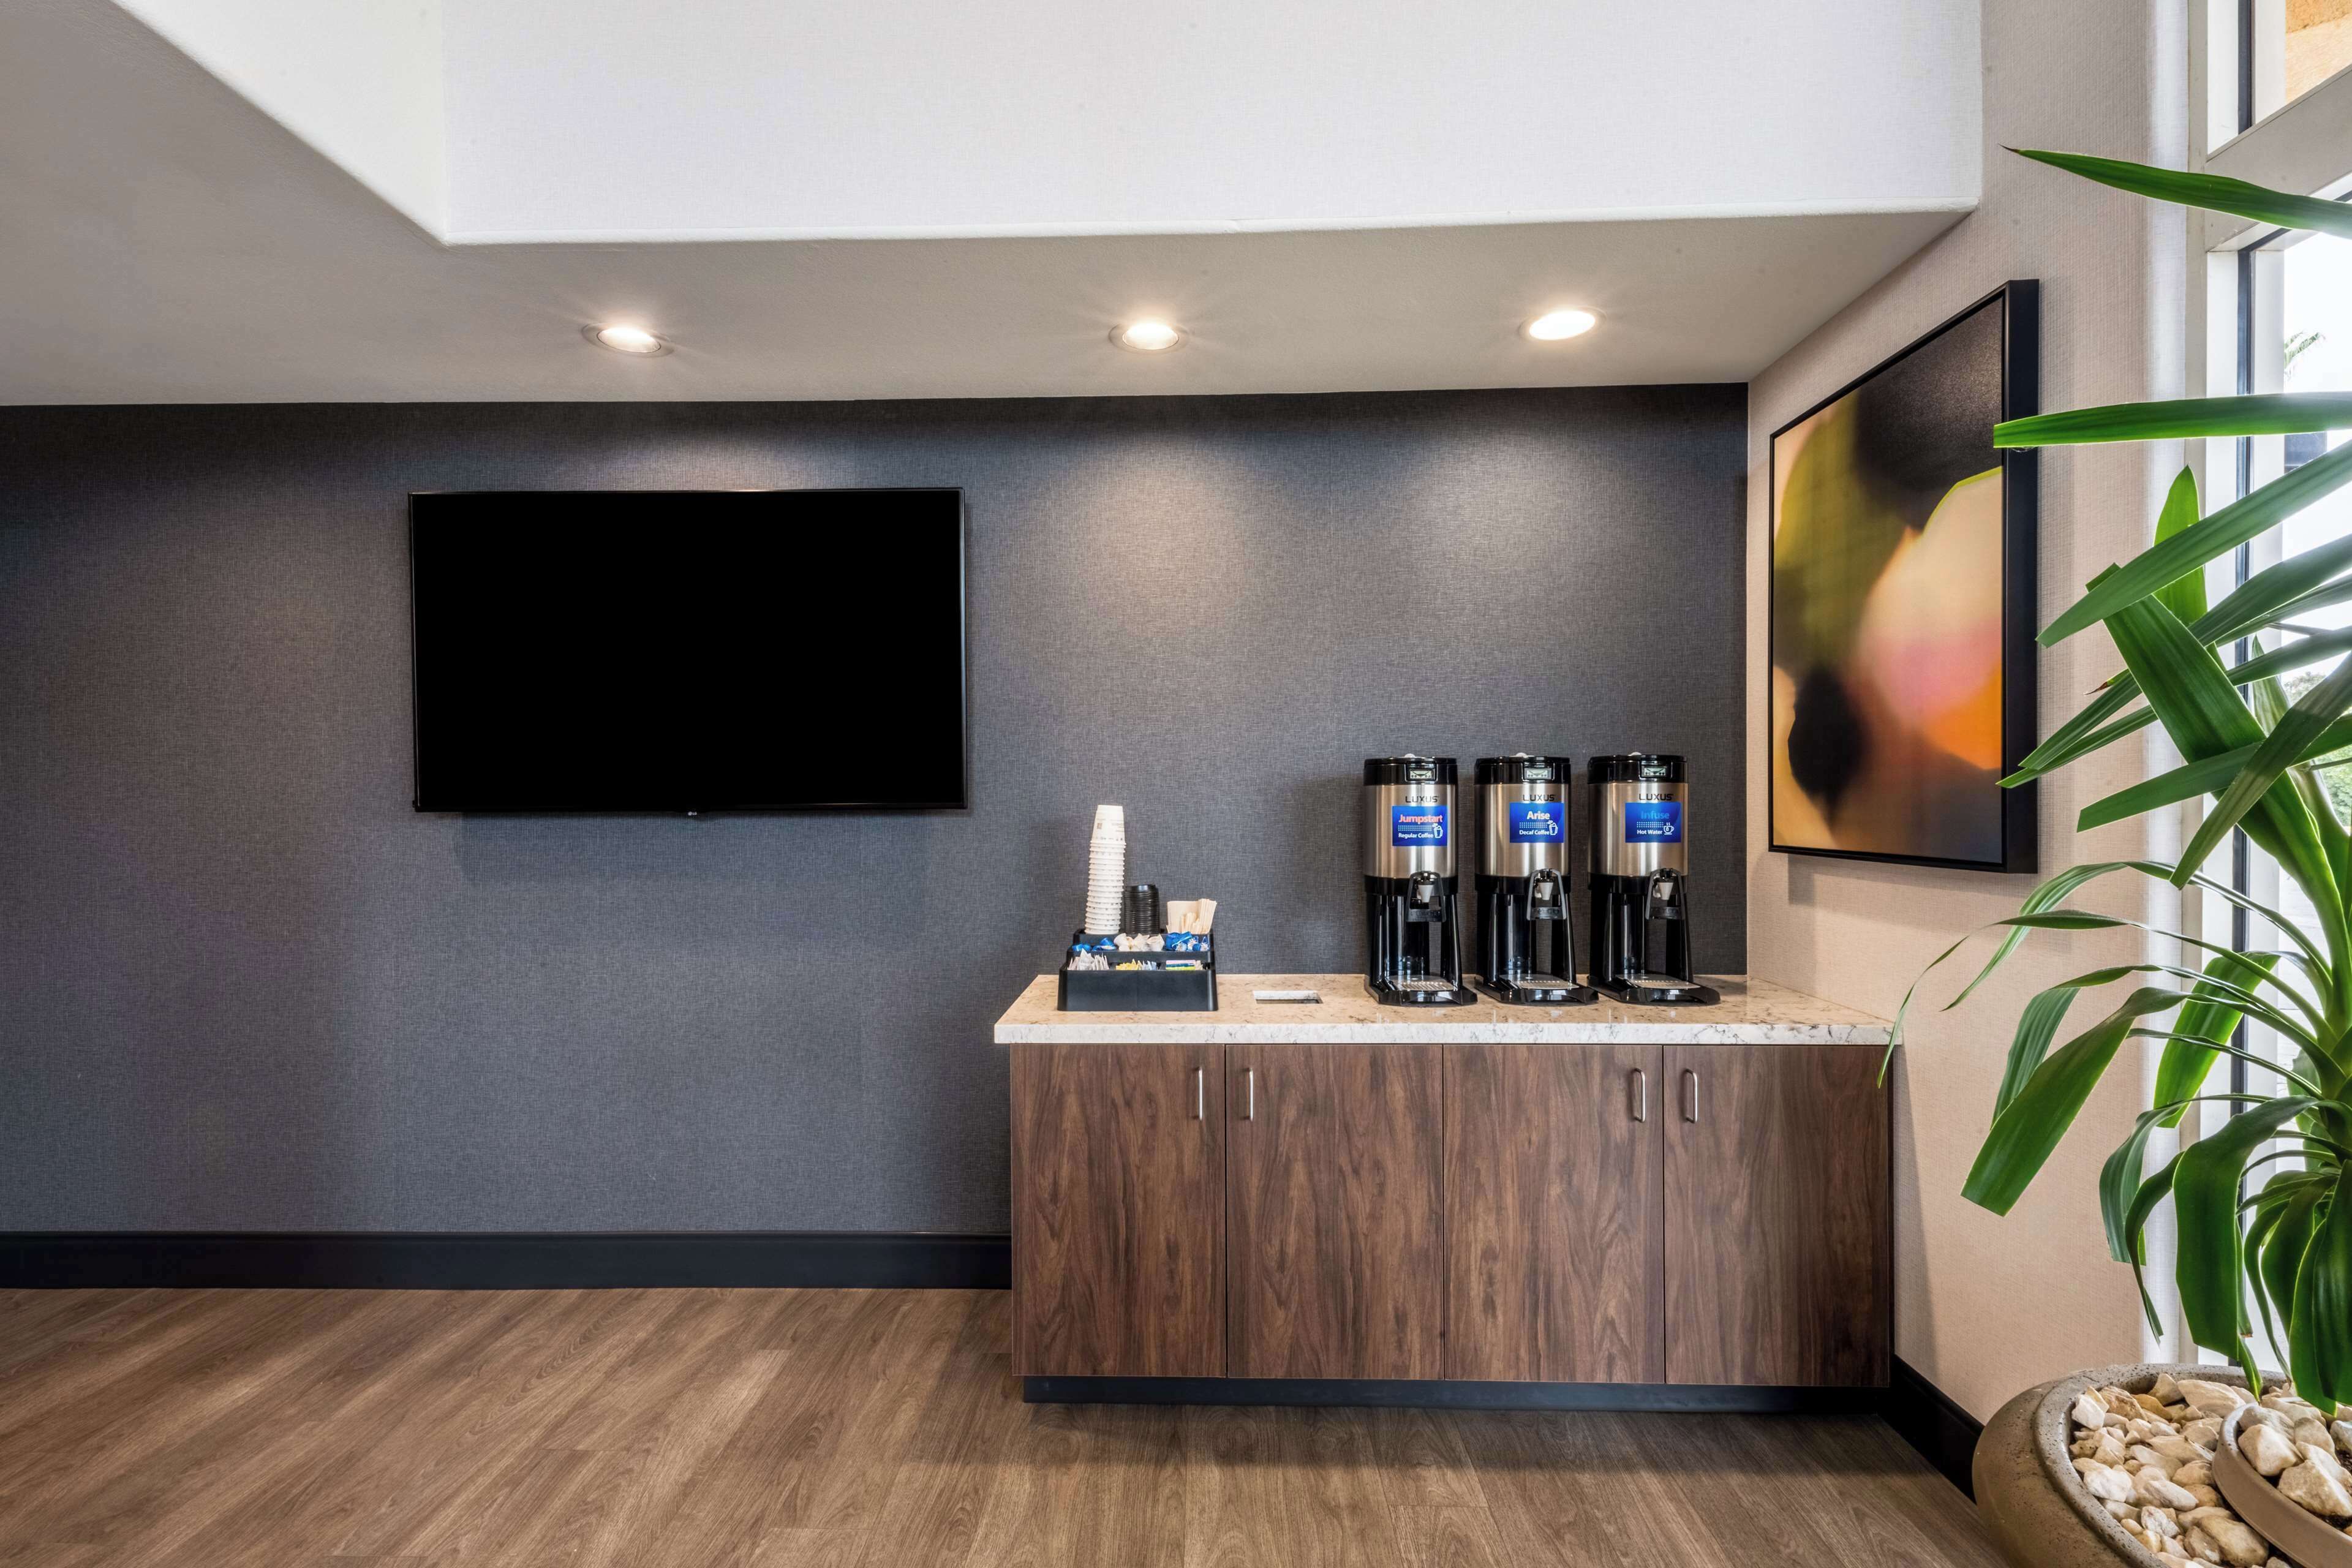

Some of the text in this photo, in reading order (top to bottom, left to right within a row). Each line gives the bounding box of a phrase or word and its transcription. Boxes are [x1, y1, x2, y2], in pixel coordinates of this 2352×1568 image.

[1398, 814, 1443, 824] Jumpstart
[1526, 811, 1550, 820] Arise
[1642, 810, 1670, 819] Infuse
